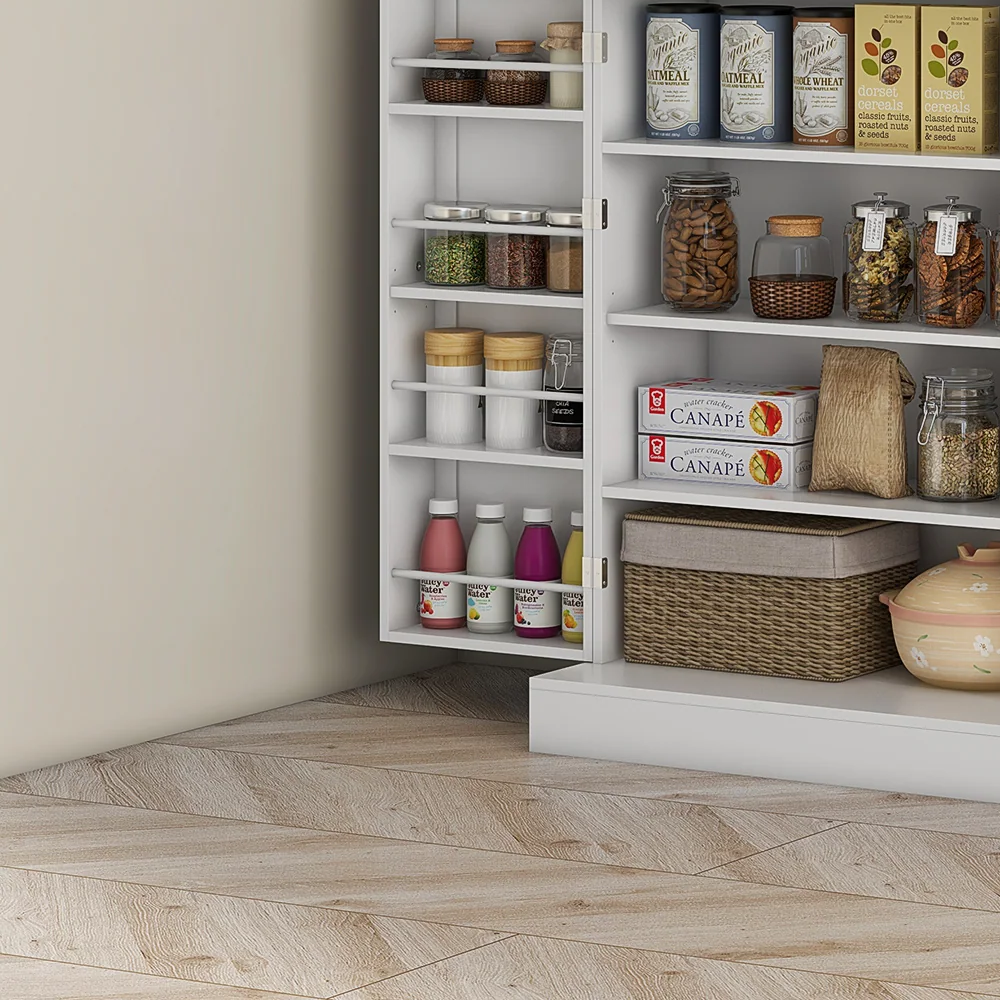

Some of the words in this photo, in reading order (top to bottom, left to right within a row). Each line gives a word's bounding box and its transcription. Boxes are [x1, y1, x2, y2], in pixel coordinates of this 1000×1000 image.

[813, 77, 844, 86] WHEAT
[858, 85, 899, 98] dorset
[924, 88, 966, 100] dorset
[858, 100, 904, 111] cereals
[924, 102, 970, 114] cereals
[858, 112, 886, 120] classic
[887, 113, 912, 122] fruits,
[924, 115, 952, 123] classic
[954, 116, 979, 124] fruits,
[858, 121, 888, 130] roasted
[890, 122, 909, 130] nuts
[924, 124, 955, 132] roasted
[934, 134, 956, 142] seeds
[684, 399, 704, 408] water
[706, 400, 734, 411] cracker
[670, 408, 746, 429] CANAPÉ
[684, 447, 704, 456] water
[706, 448, 734, 459] cracker
[670, 456, 746, 477] CANAPÉ
